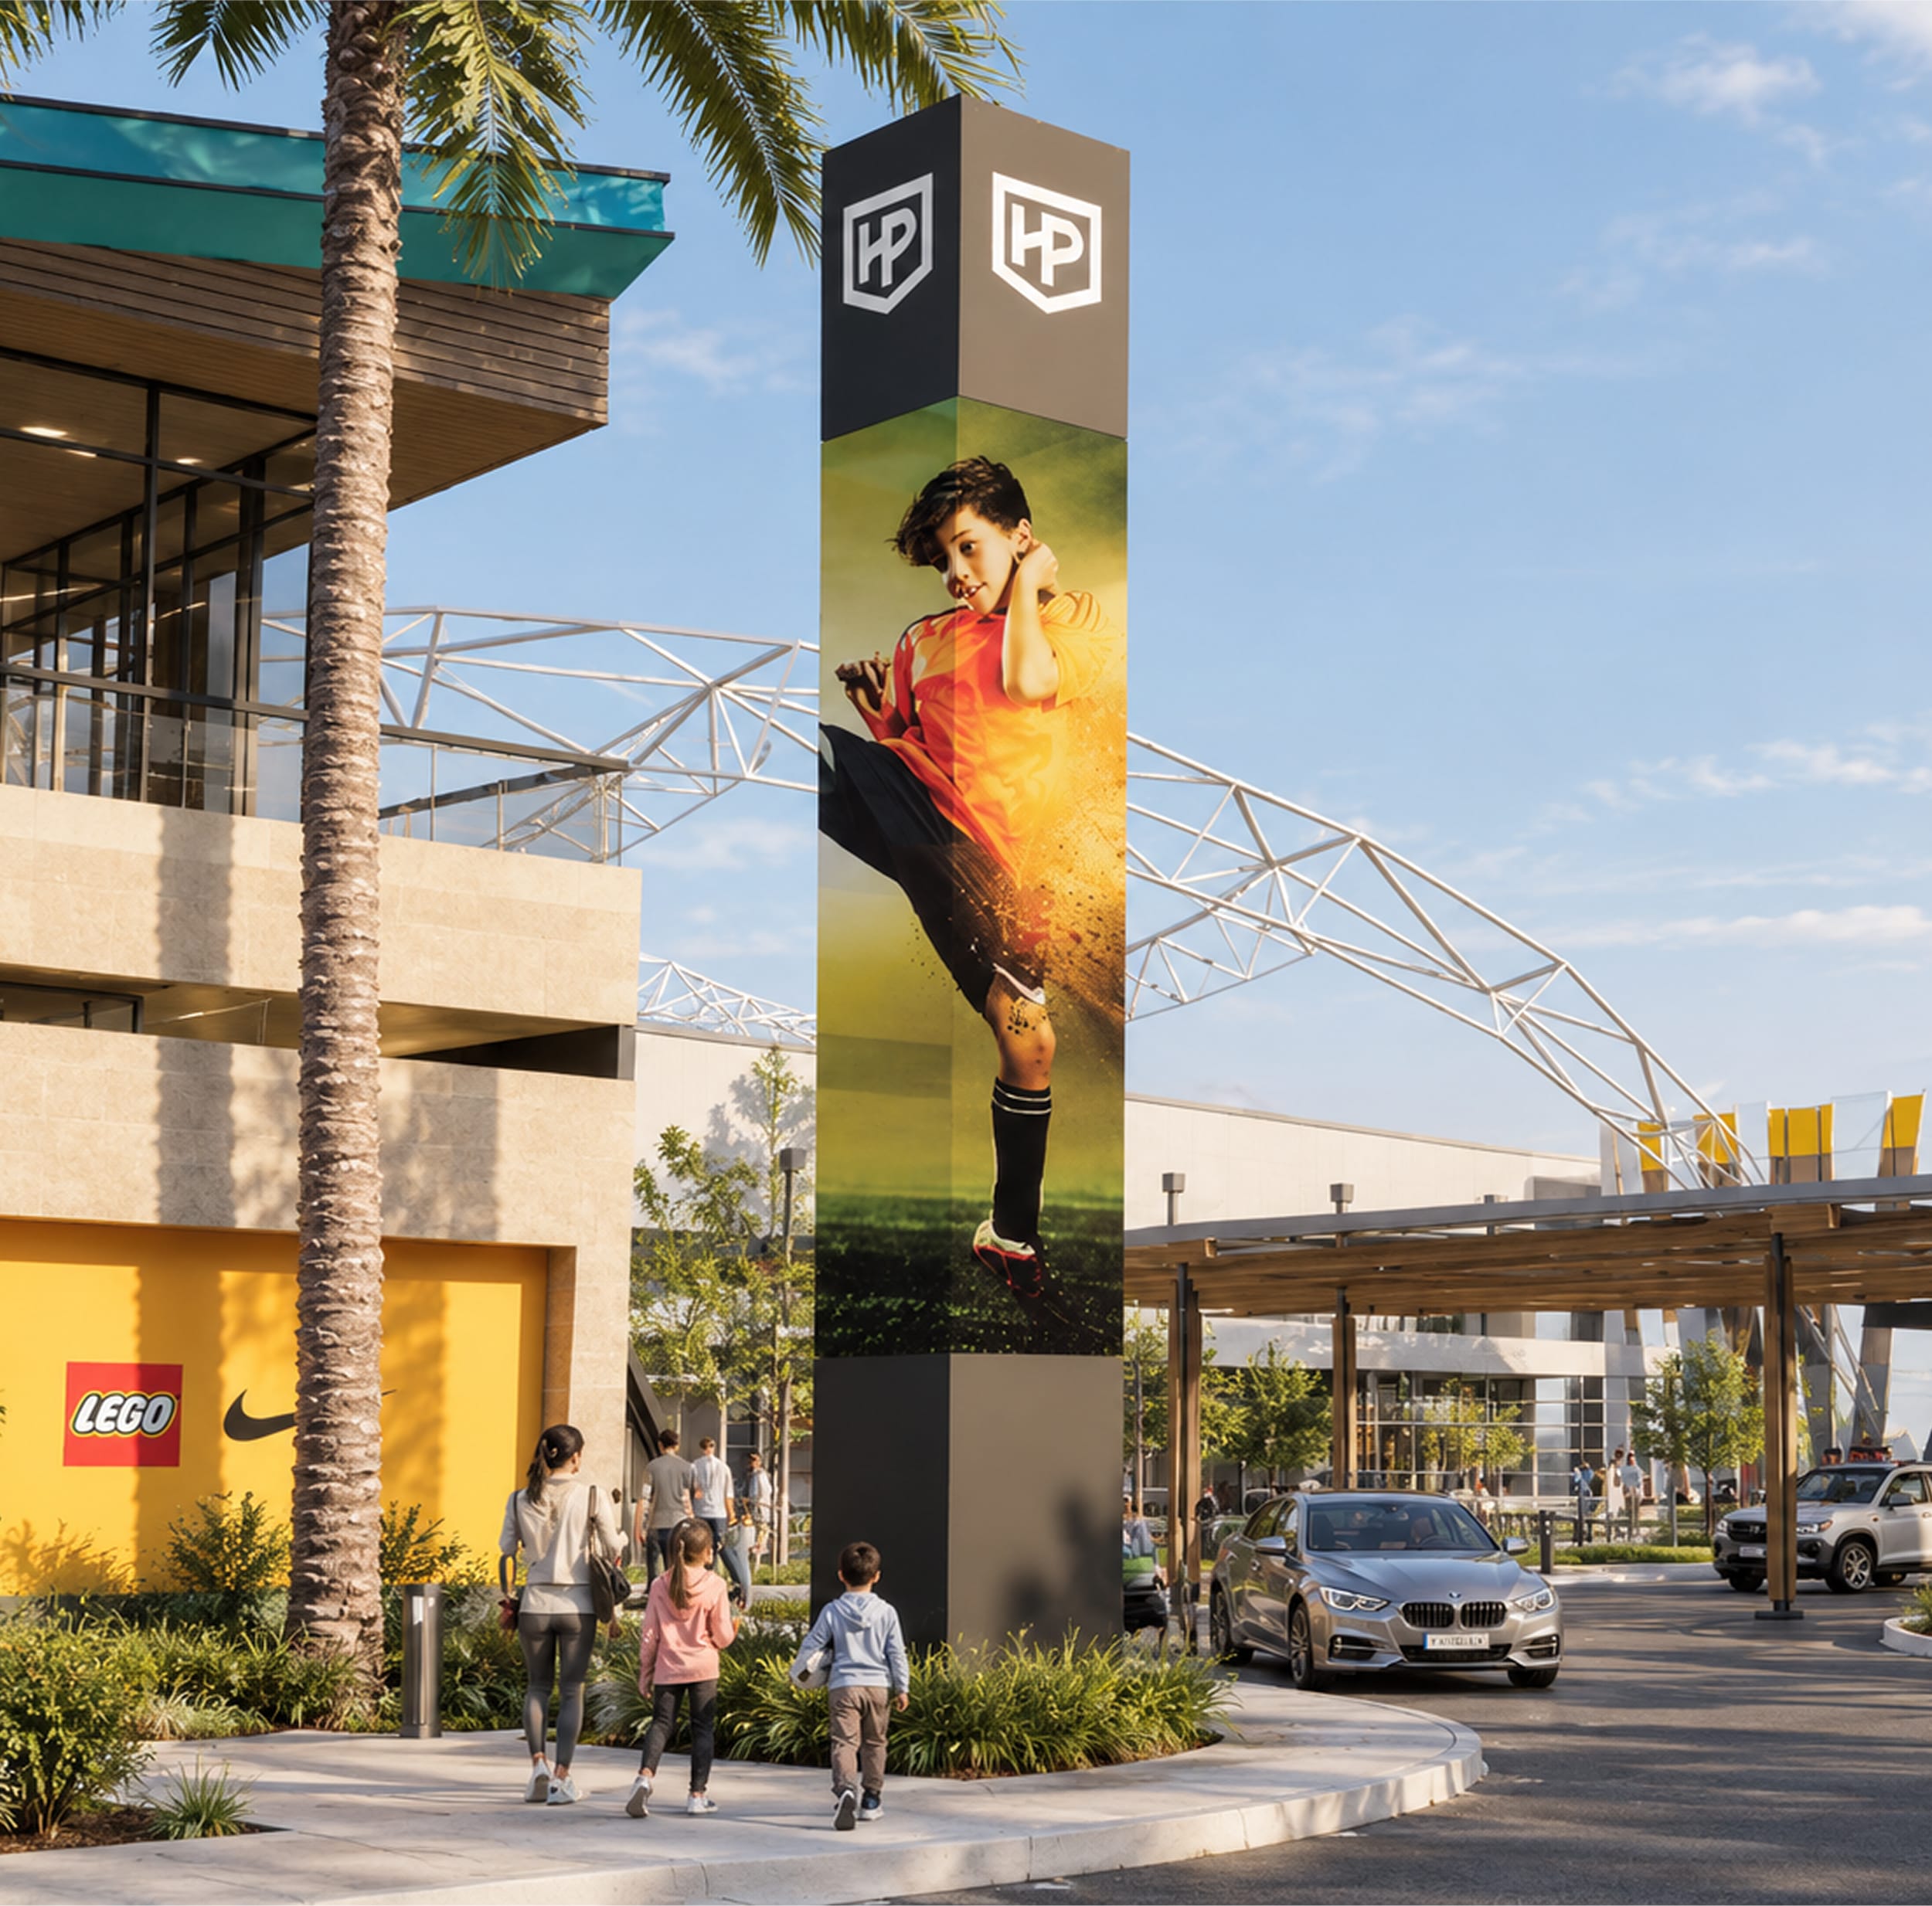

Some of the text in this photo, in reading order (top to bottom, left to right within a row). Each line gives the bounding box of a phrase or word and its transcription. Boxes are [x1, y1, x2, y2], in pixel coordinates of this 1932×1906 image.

[859, 207, 917, 288] HP
[1012, 202, 1084, 287] HP
[73, 1392, 175, 1435] LEGO
